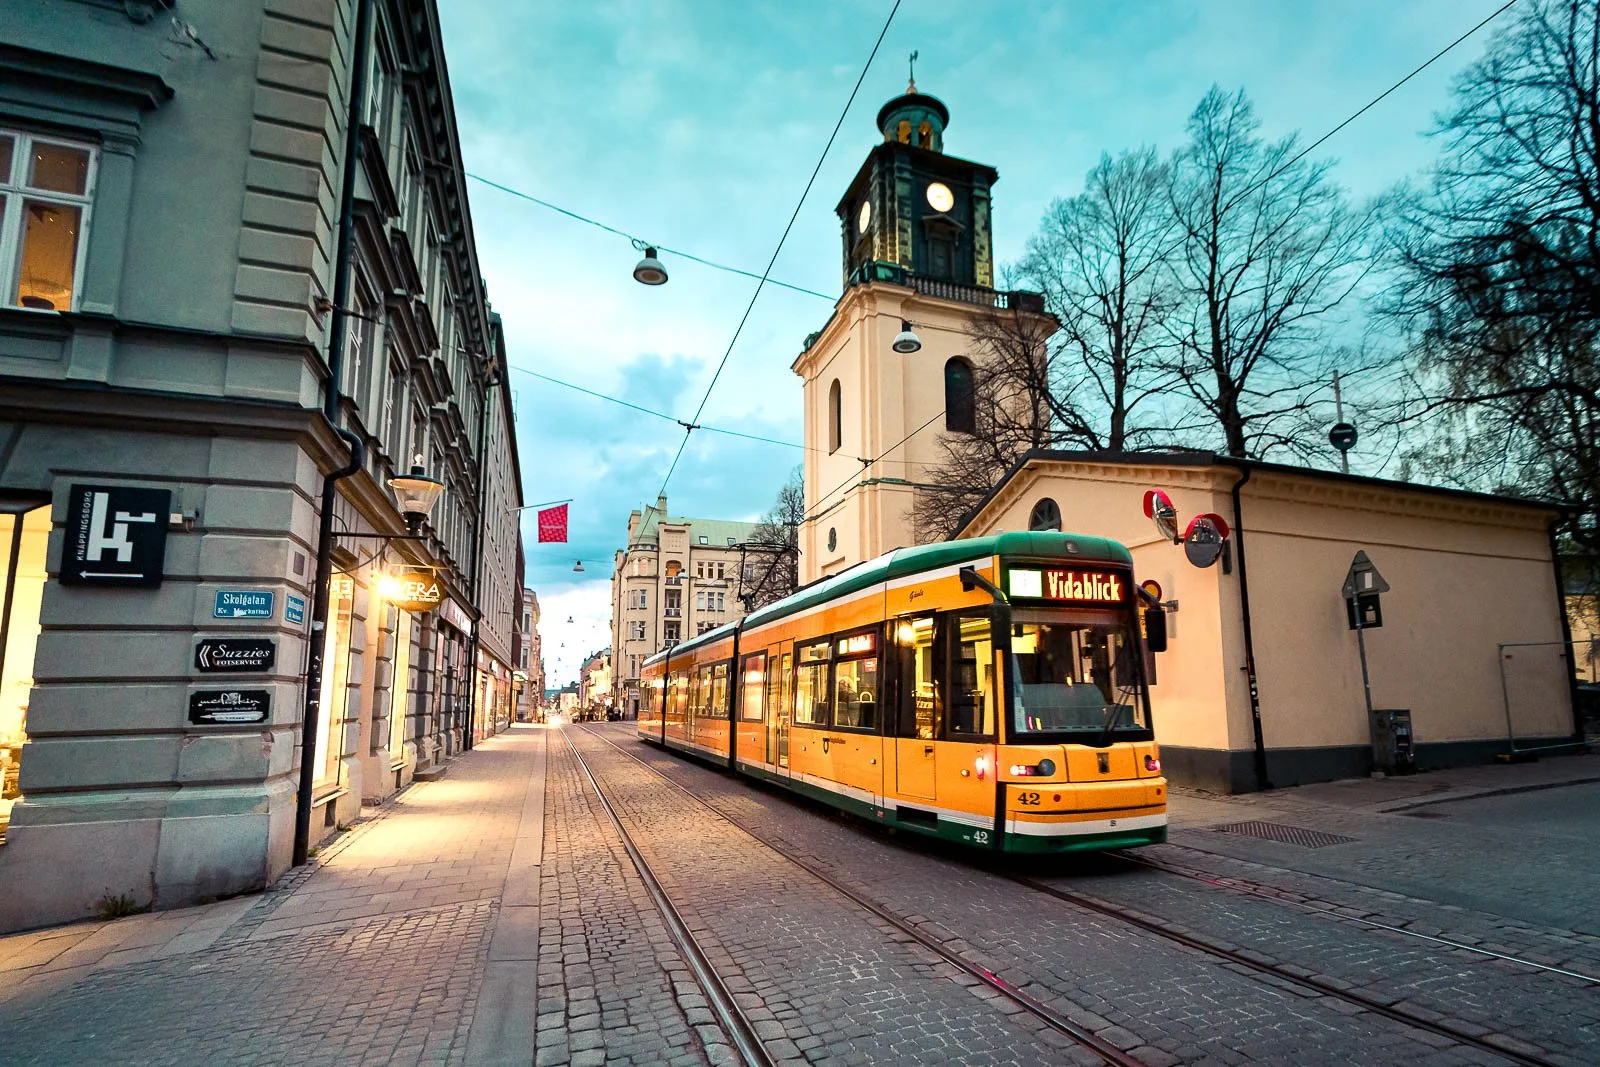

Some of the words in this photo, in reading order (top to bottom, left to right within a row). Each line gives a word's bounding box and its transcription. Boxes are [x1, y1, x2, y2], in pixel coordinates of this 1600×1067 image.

[76, 491, 93, 561] KNAPPINGSBORG
[1048, 571, 1121, 601] Vidablick
[223, 593, 266, 606] Skolgatan
[212, 644, 271, 658] Suzzies
[1017, 792, 1041, 805] 42
[973, 830, 988, 845] 42
